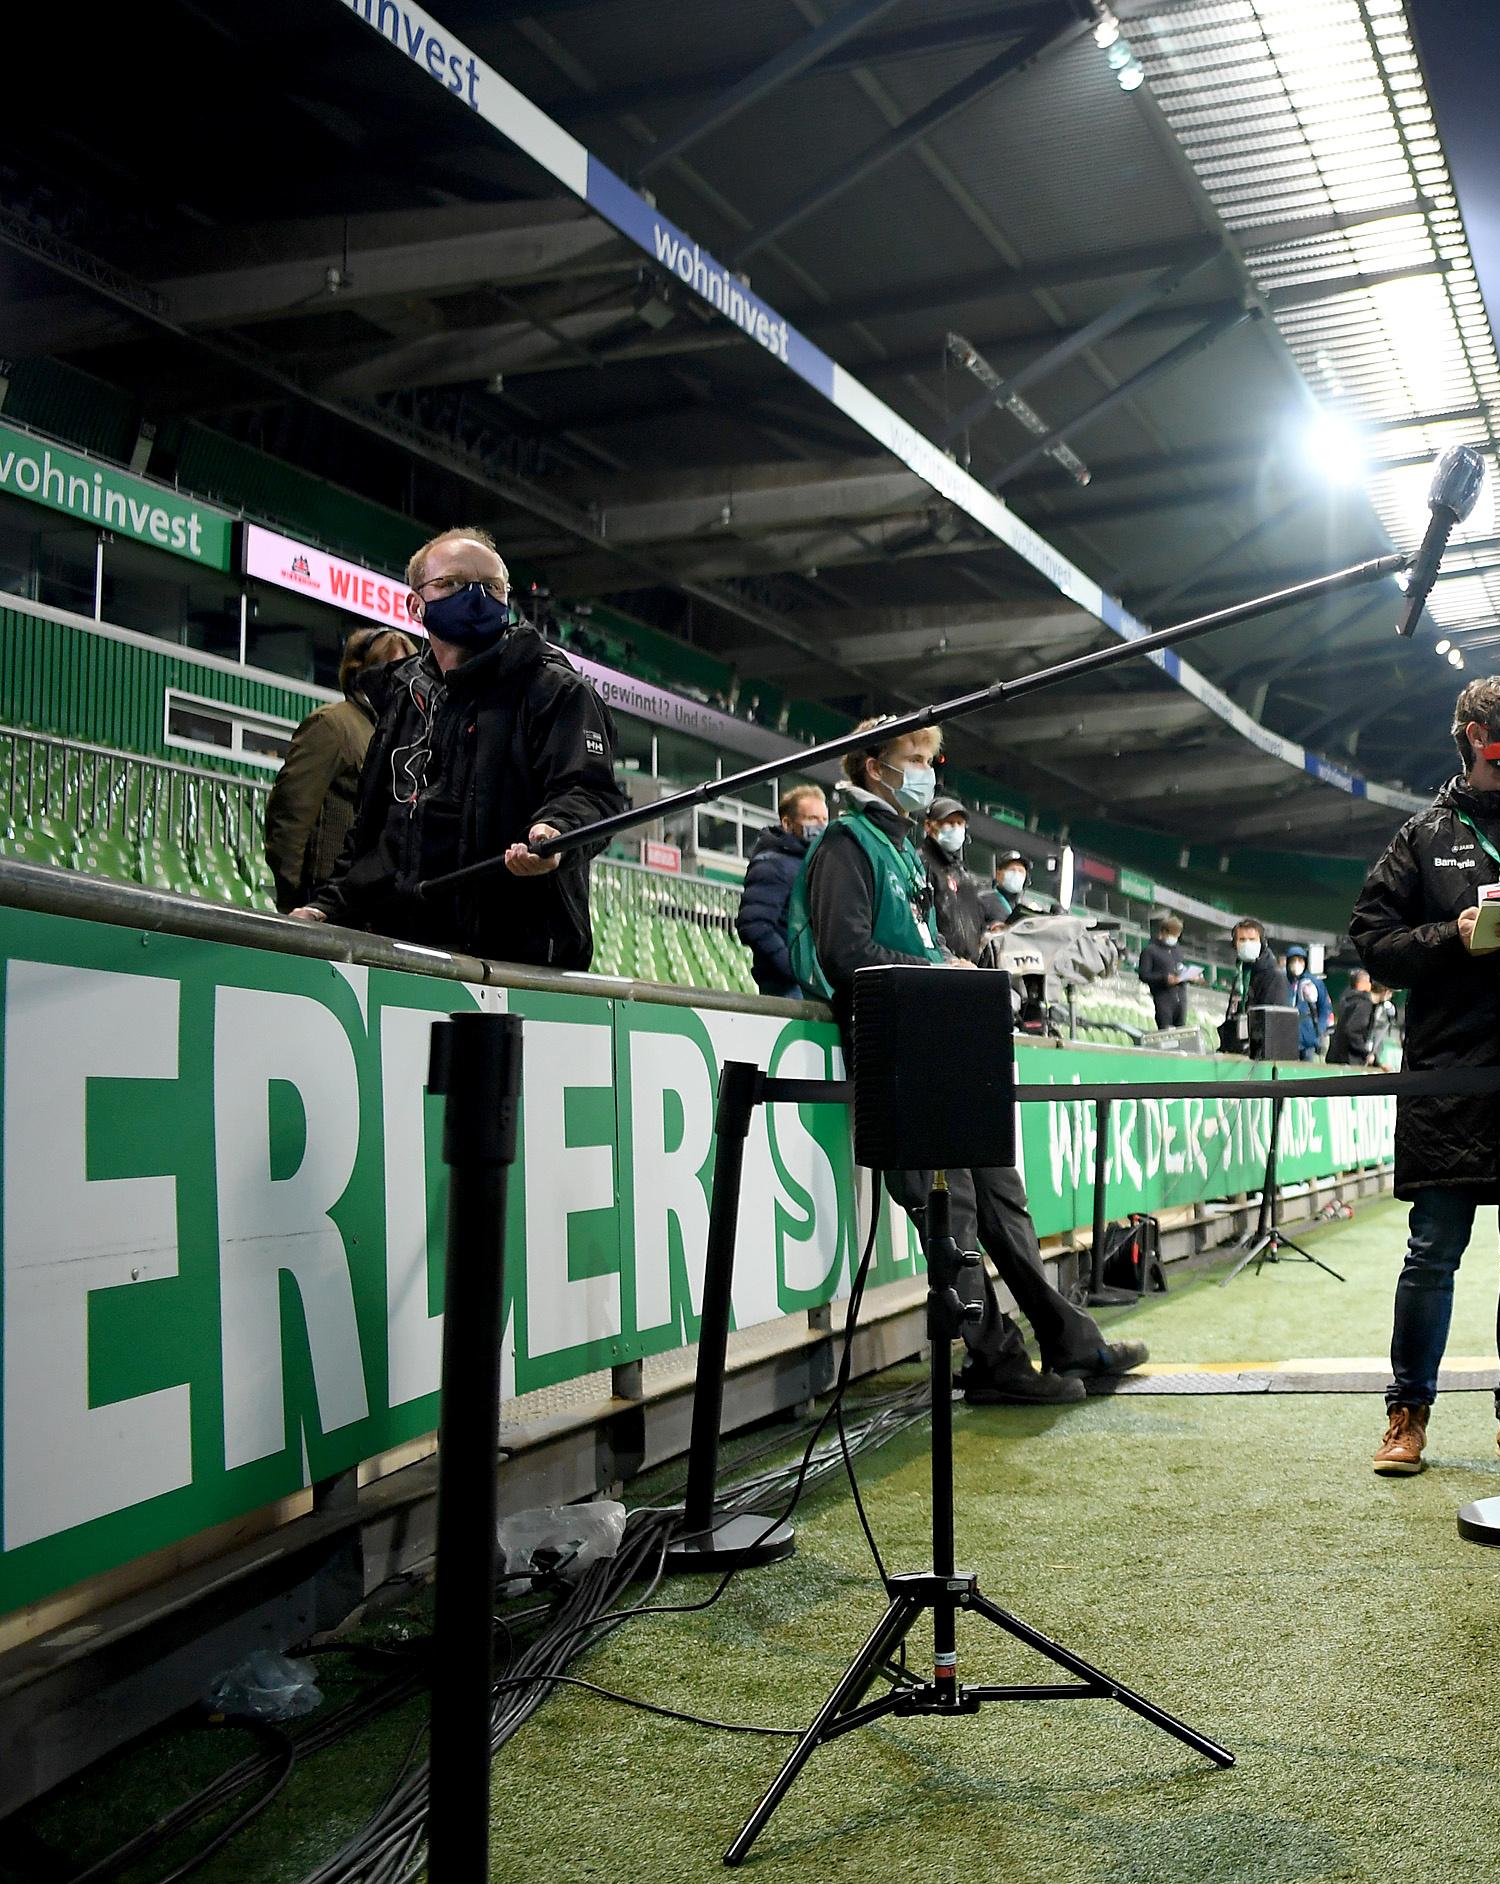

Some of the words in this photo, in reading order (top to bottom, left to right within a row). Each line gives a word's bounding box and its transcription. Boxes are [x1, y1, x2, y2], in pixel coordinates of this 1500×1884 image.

[654, 224, 789, 362] wohninvest
[329, 565, 407, 623] WIESE
[675, 704, 698, 728] Und
